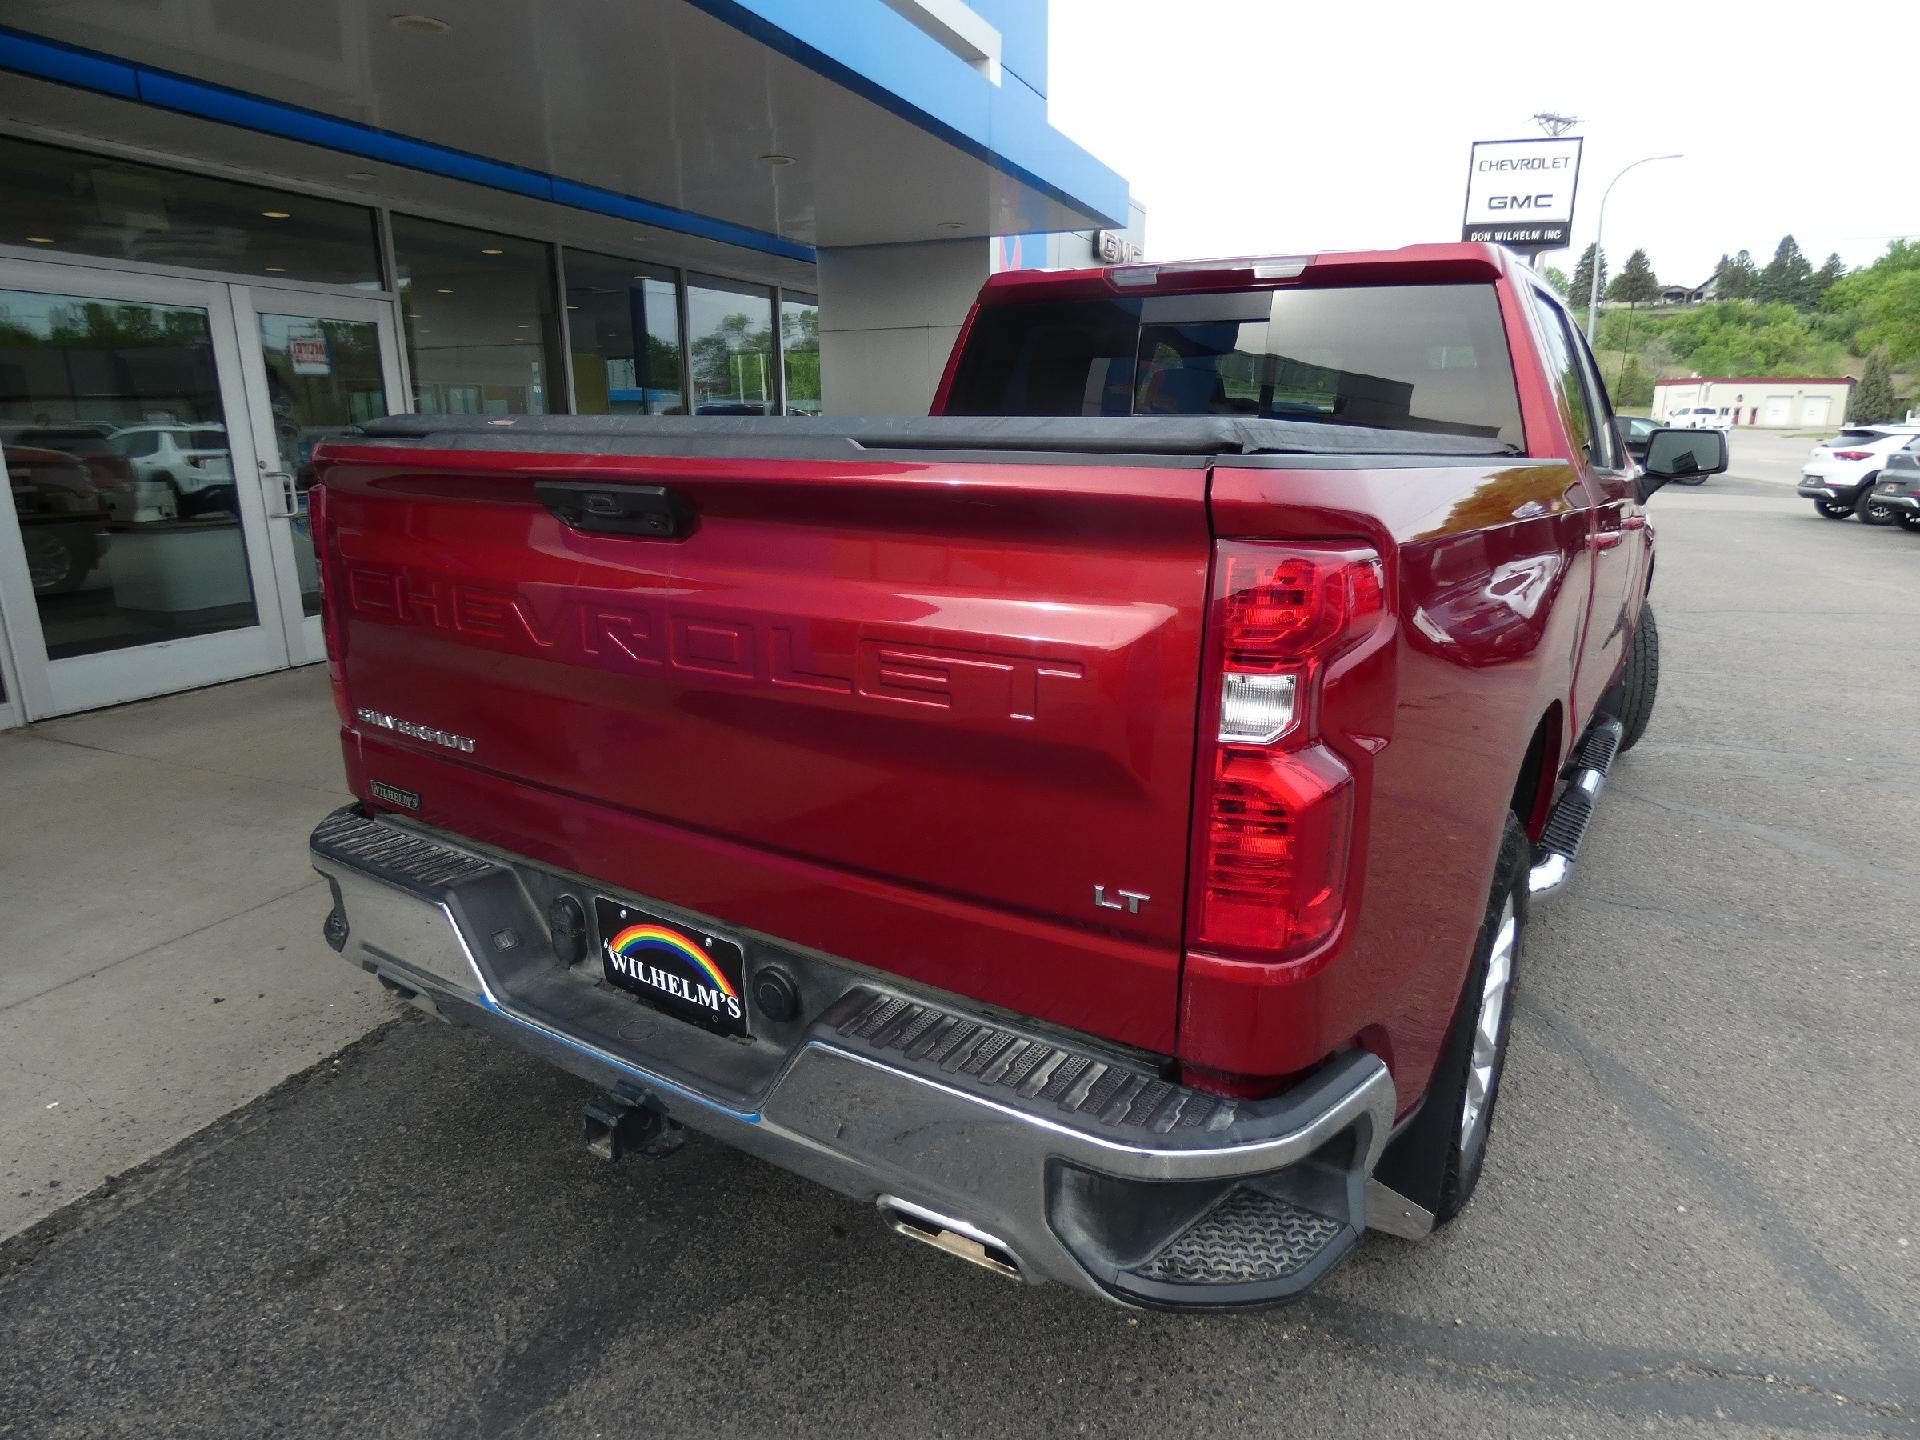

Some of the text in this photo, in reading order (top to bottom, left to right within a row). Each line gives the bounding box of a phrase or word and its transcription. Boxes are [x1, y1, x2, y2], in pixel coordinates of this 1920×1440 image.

[1479, 157, 1570, 171] CHEVROLET
[1488, 194, 1553, 209] GMC
[1470, 229, 1561, 242] DON WILHELM INC
[350, 567, 1085, 722] CHEVROLET
[1094, 884, 1151, 914] LT
